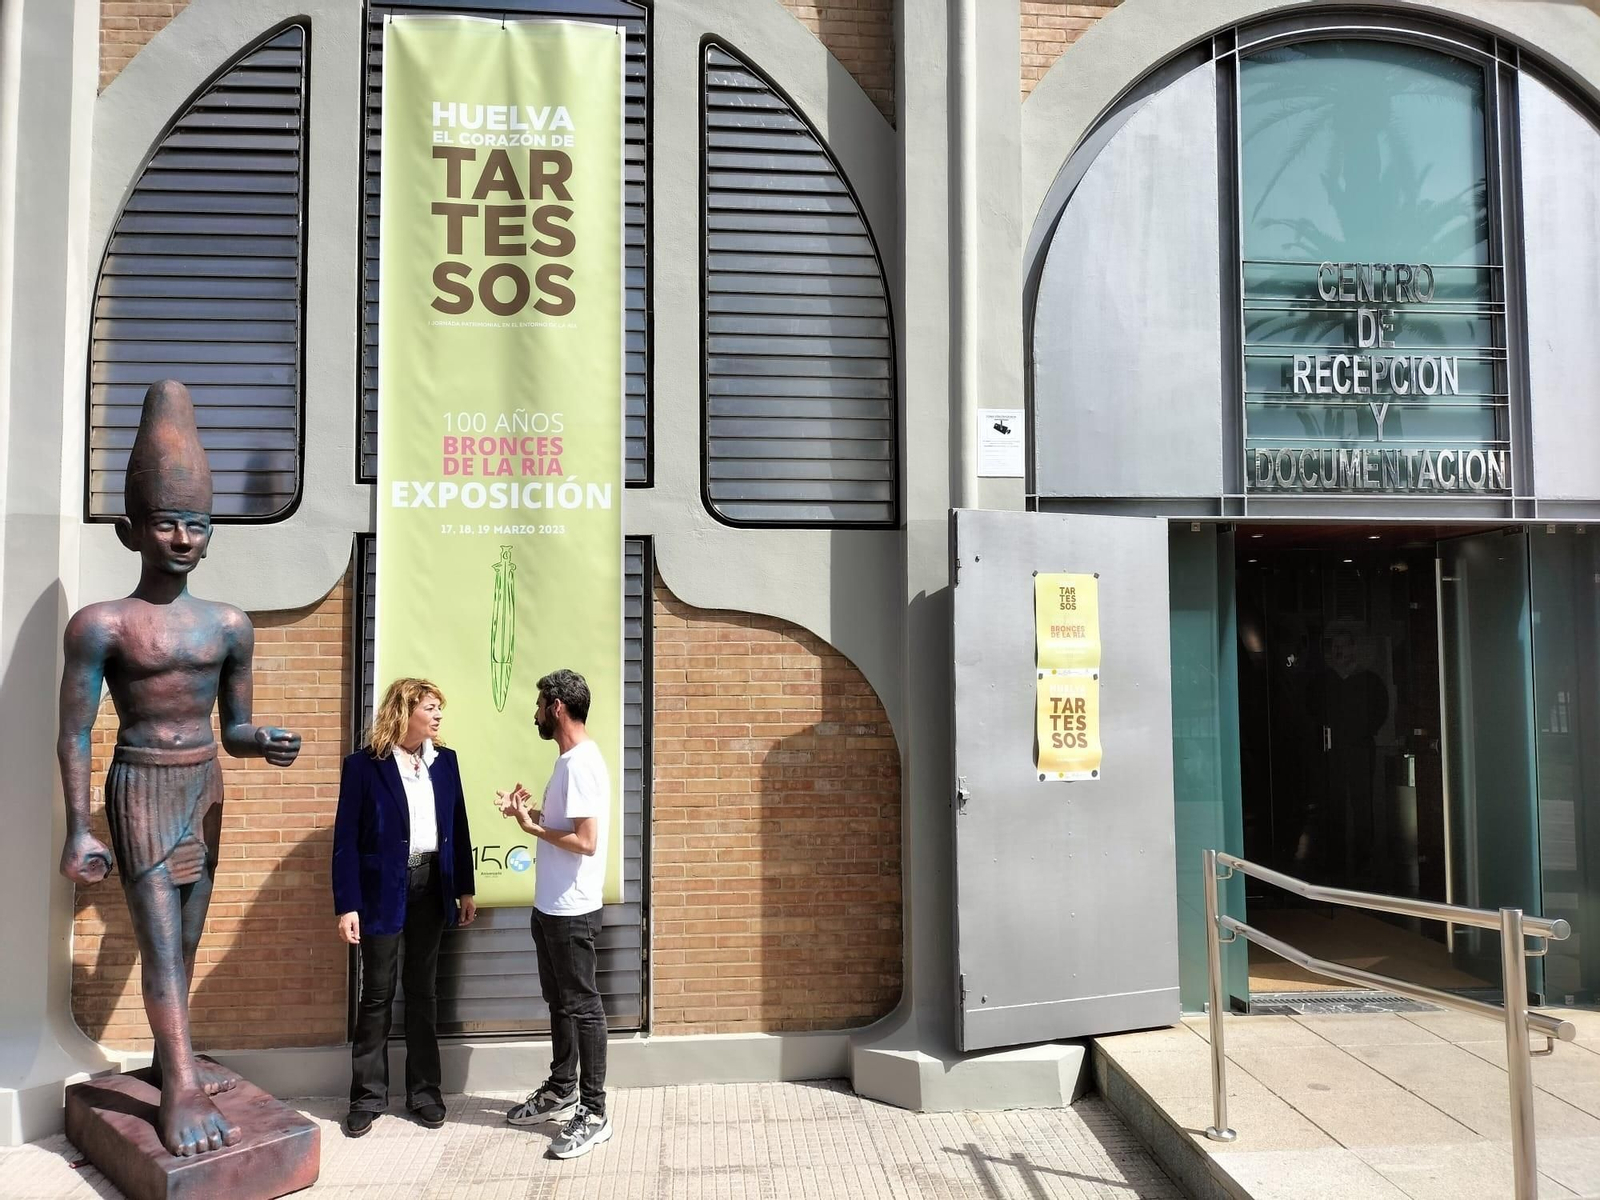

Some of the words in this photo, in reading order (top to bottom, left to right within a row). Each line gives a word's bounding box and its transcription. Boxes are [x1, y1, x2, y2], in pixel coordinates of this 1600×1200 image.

[432, 101, 575, 131] HUELVA
[433, 131, 454, 144] EL
[459, 131, 546, 147] CORAZÓN
[551, 134, 574, 147] DE
[432, 146, 574, 201] TAR
[431, 202, 576, 257] TES
[430, 261, 576, 316] SOS
[1317, 261, 1435, 303] CENTRO
[1357, 308, 1396, 349] DE
[1292, 354, 1459, 395] RECEPCION
[443, 412, 486, 432] 100
[494, 408, 564, 432] AÑOS
[1369, 402, 1389, 441] Y
[443, 436, 563, 456] BRONCES
[443, 457, 473, 476] DE
[482, 458, 513, 476] LA
[521, 454, 563, 476] RÍA
[1255, 448, 1505, 490] DOCUMENTACION
[391, 475, 612, 509] EXPOSICIÓN
[441, 524, 456, 535] 17,
[459, 524, 475, 535] 18,
[478, 524, 490, 535] 19
[493, 524, 535, 535] MARZO
[538, 524, 566, 535] 2023
[1059, 587, 1076, 595] TAR
[1050, 697, 1086, 714] TAR
[1049, 715, 1087, 731] TES
[1051, 732, 1088, 748] SOS
